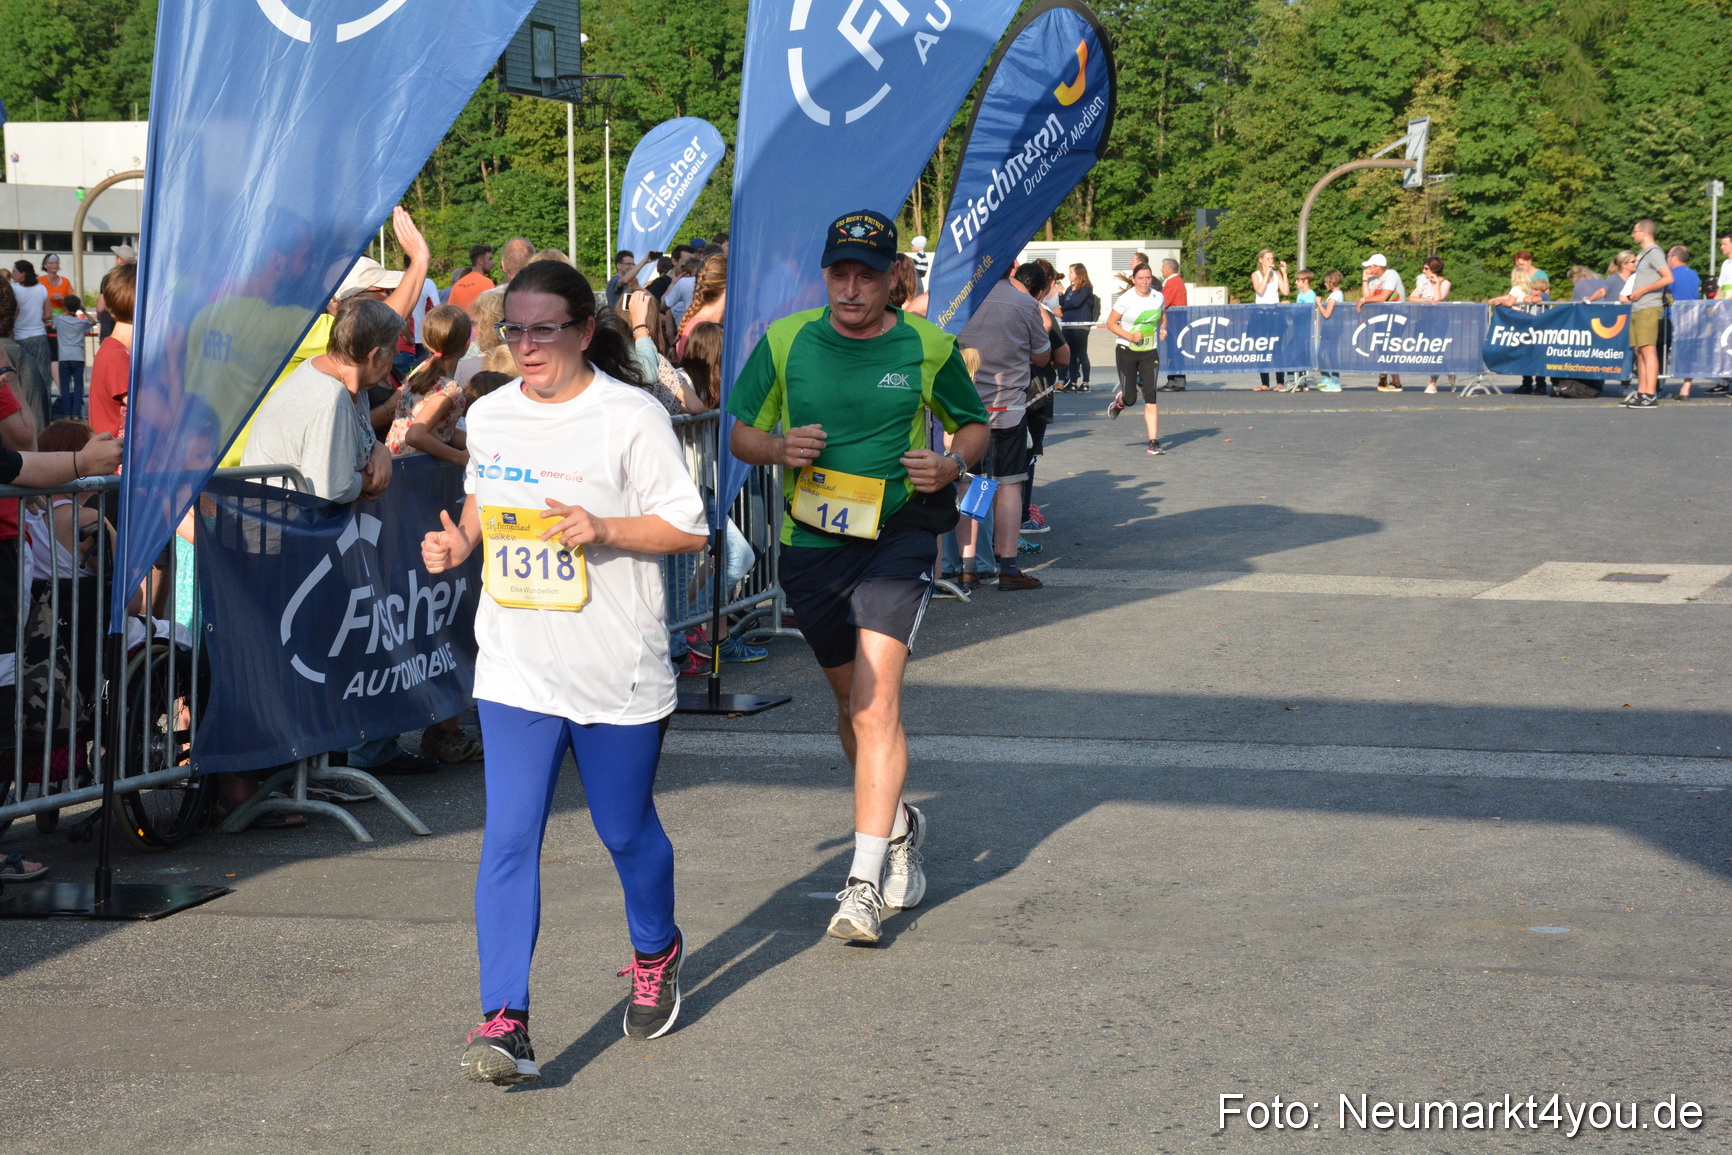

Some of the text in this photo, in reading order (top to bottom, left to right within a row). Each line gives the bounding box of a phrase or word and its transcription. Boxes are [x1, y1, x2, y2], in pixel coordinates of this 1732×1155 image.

[1023, 158, 1052, 195] Druck
[1069, 96, 1105, 145] Medien
[645, 135, 701, 218] Fischer
[665, 151, 709, 217] AUTOMOBILE
[950, 112, 1065, 254] Frischmann
[1195, 332, 1280, 353] Fischer
[1369, 332, 1453, 353] Fischer
[1490, 325, 1592, 347] Frischmann
[1203, 353, 1273, 364] AUTOMOBILE
[1377, 354, 1444, 364] AUTOMOBILE
[1546, 346, 1624, 359] Druck und Medien
[1546, 363, 1622, 374] www.frischmann-net.de
[879, 372, 910, 387] AOK
[540, 469, 583, 483] energie
[816, 502, 849, 533] 14
[495, 545, 576, 582] 1318
[510, 585, 559, 595] Elke Wunderlich
[328, 568, 467, 658] Fischer
[342, 642, 457, 700] AUTOMOBILE
